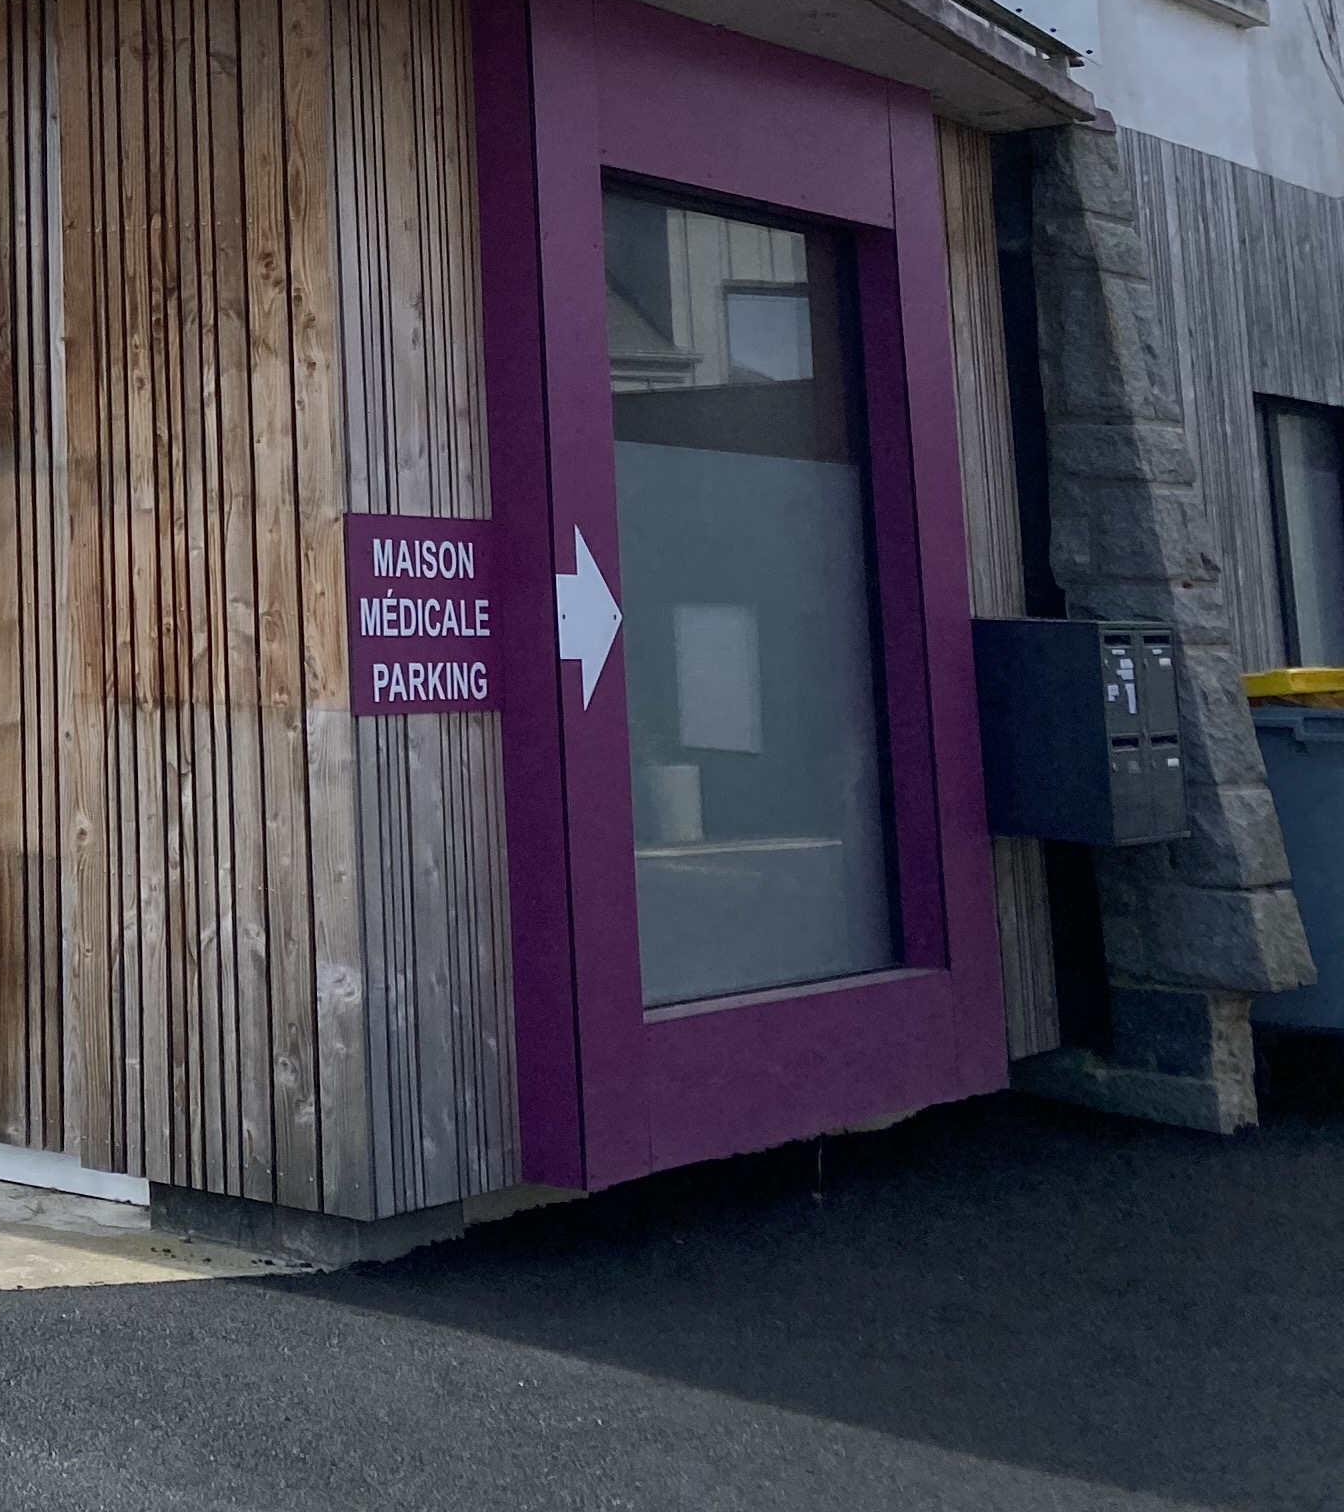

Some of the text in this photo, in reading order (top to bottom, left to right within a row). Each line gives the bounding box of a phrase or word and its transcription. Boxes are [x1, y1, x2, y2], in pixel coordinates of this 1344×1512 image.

[372, 538, 475, 579] MAISON
[360, 589, 491, 637] MÉDICALE
[372, 661, 488, 703] PARKING
